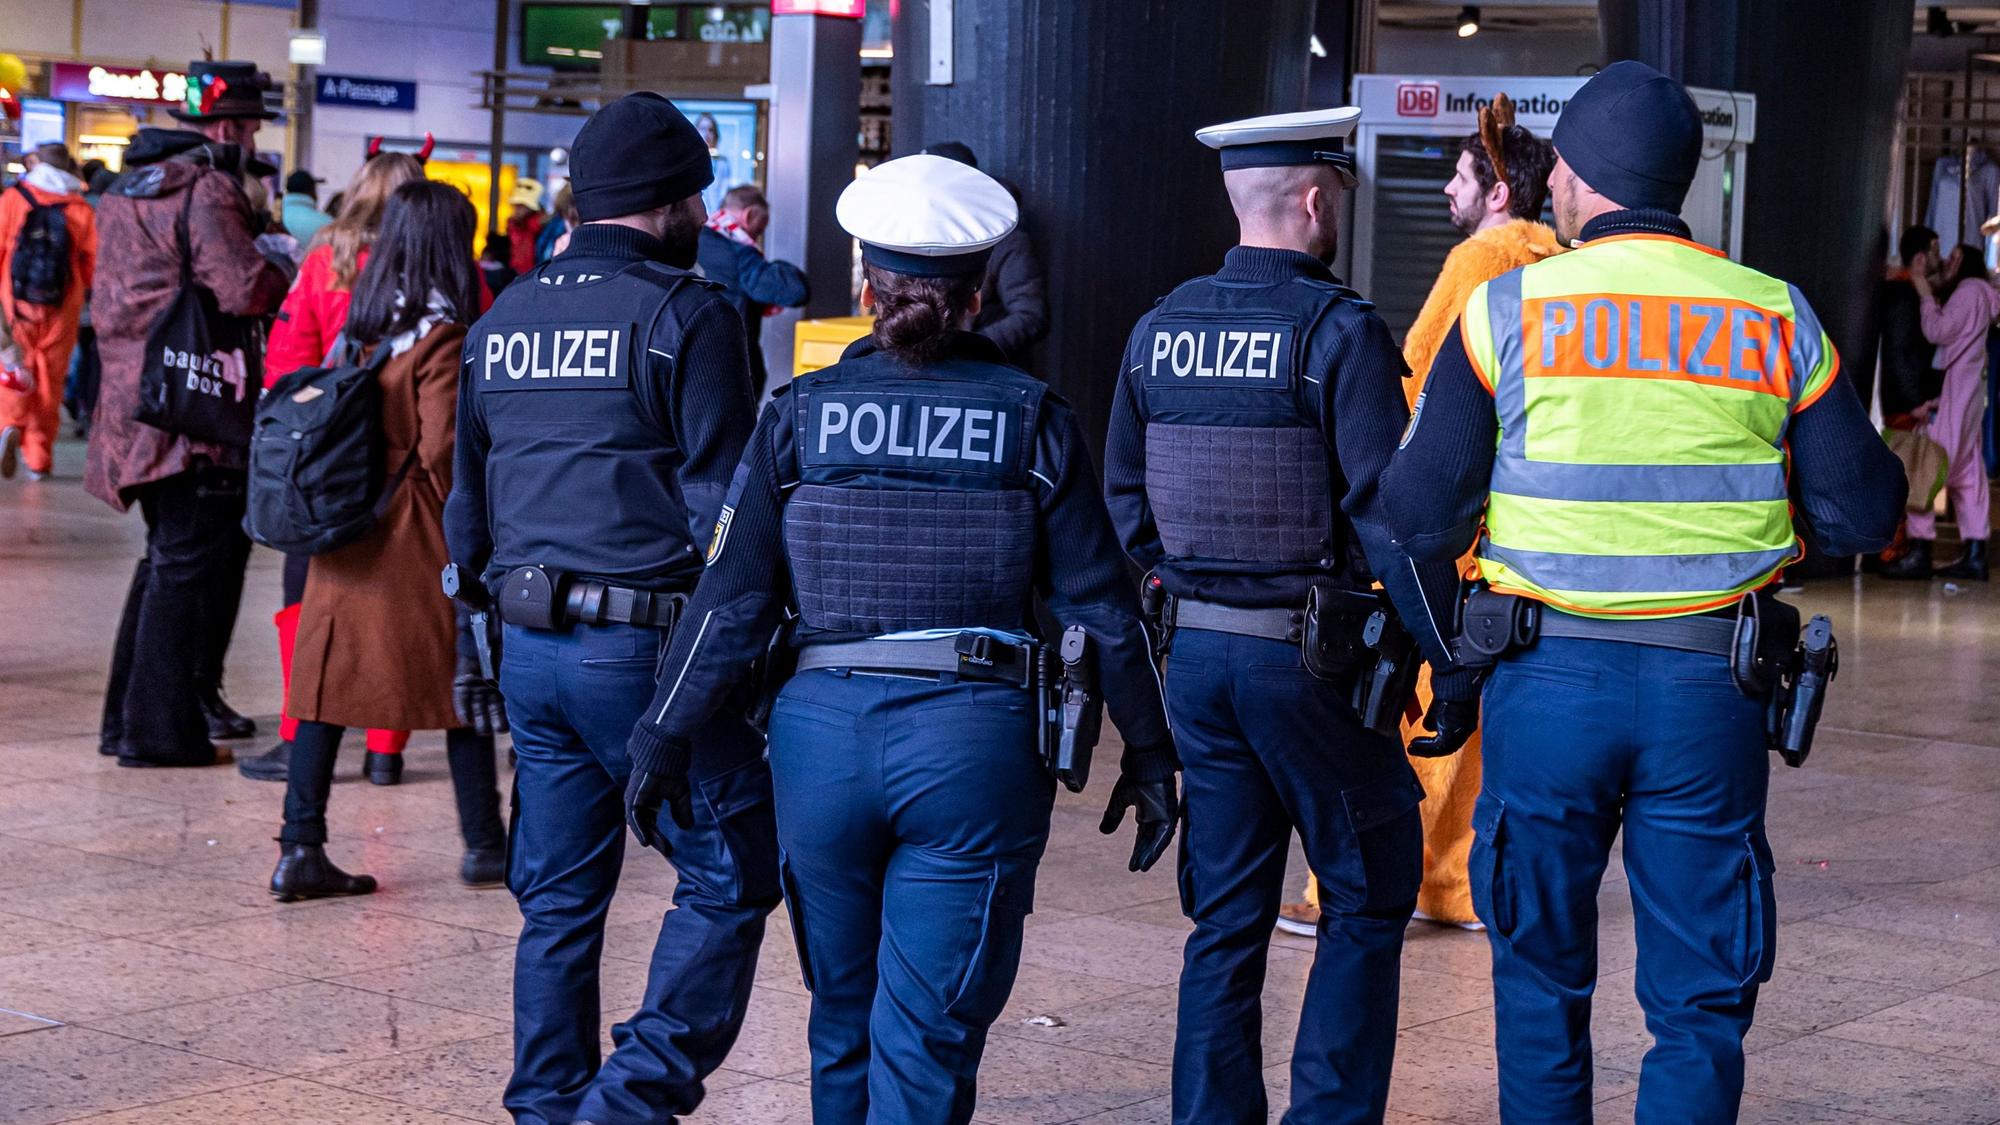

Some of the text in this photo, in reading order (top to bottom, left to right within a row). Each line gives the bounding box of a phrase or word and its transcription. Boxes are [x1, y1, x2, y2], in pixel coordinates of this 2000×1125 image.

[1403, 90, 1433, 111] DB
[1701, 106, 1733, 128] ation
[484, 329, 620, 380] POLIZEI
[1151, 331, 1281, 378] POLIZEI
[1541, 298, 1782, 387] POLIZEI
[186, 368, 223, 398] box
[818, 402, 1007, 463] POLIZEI
